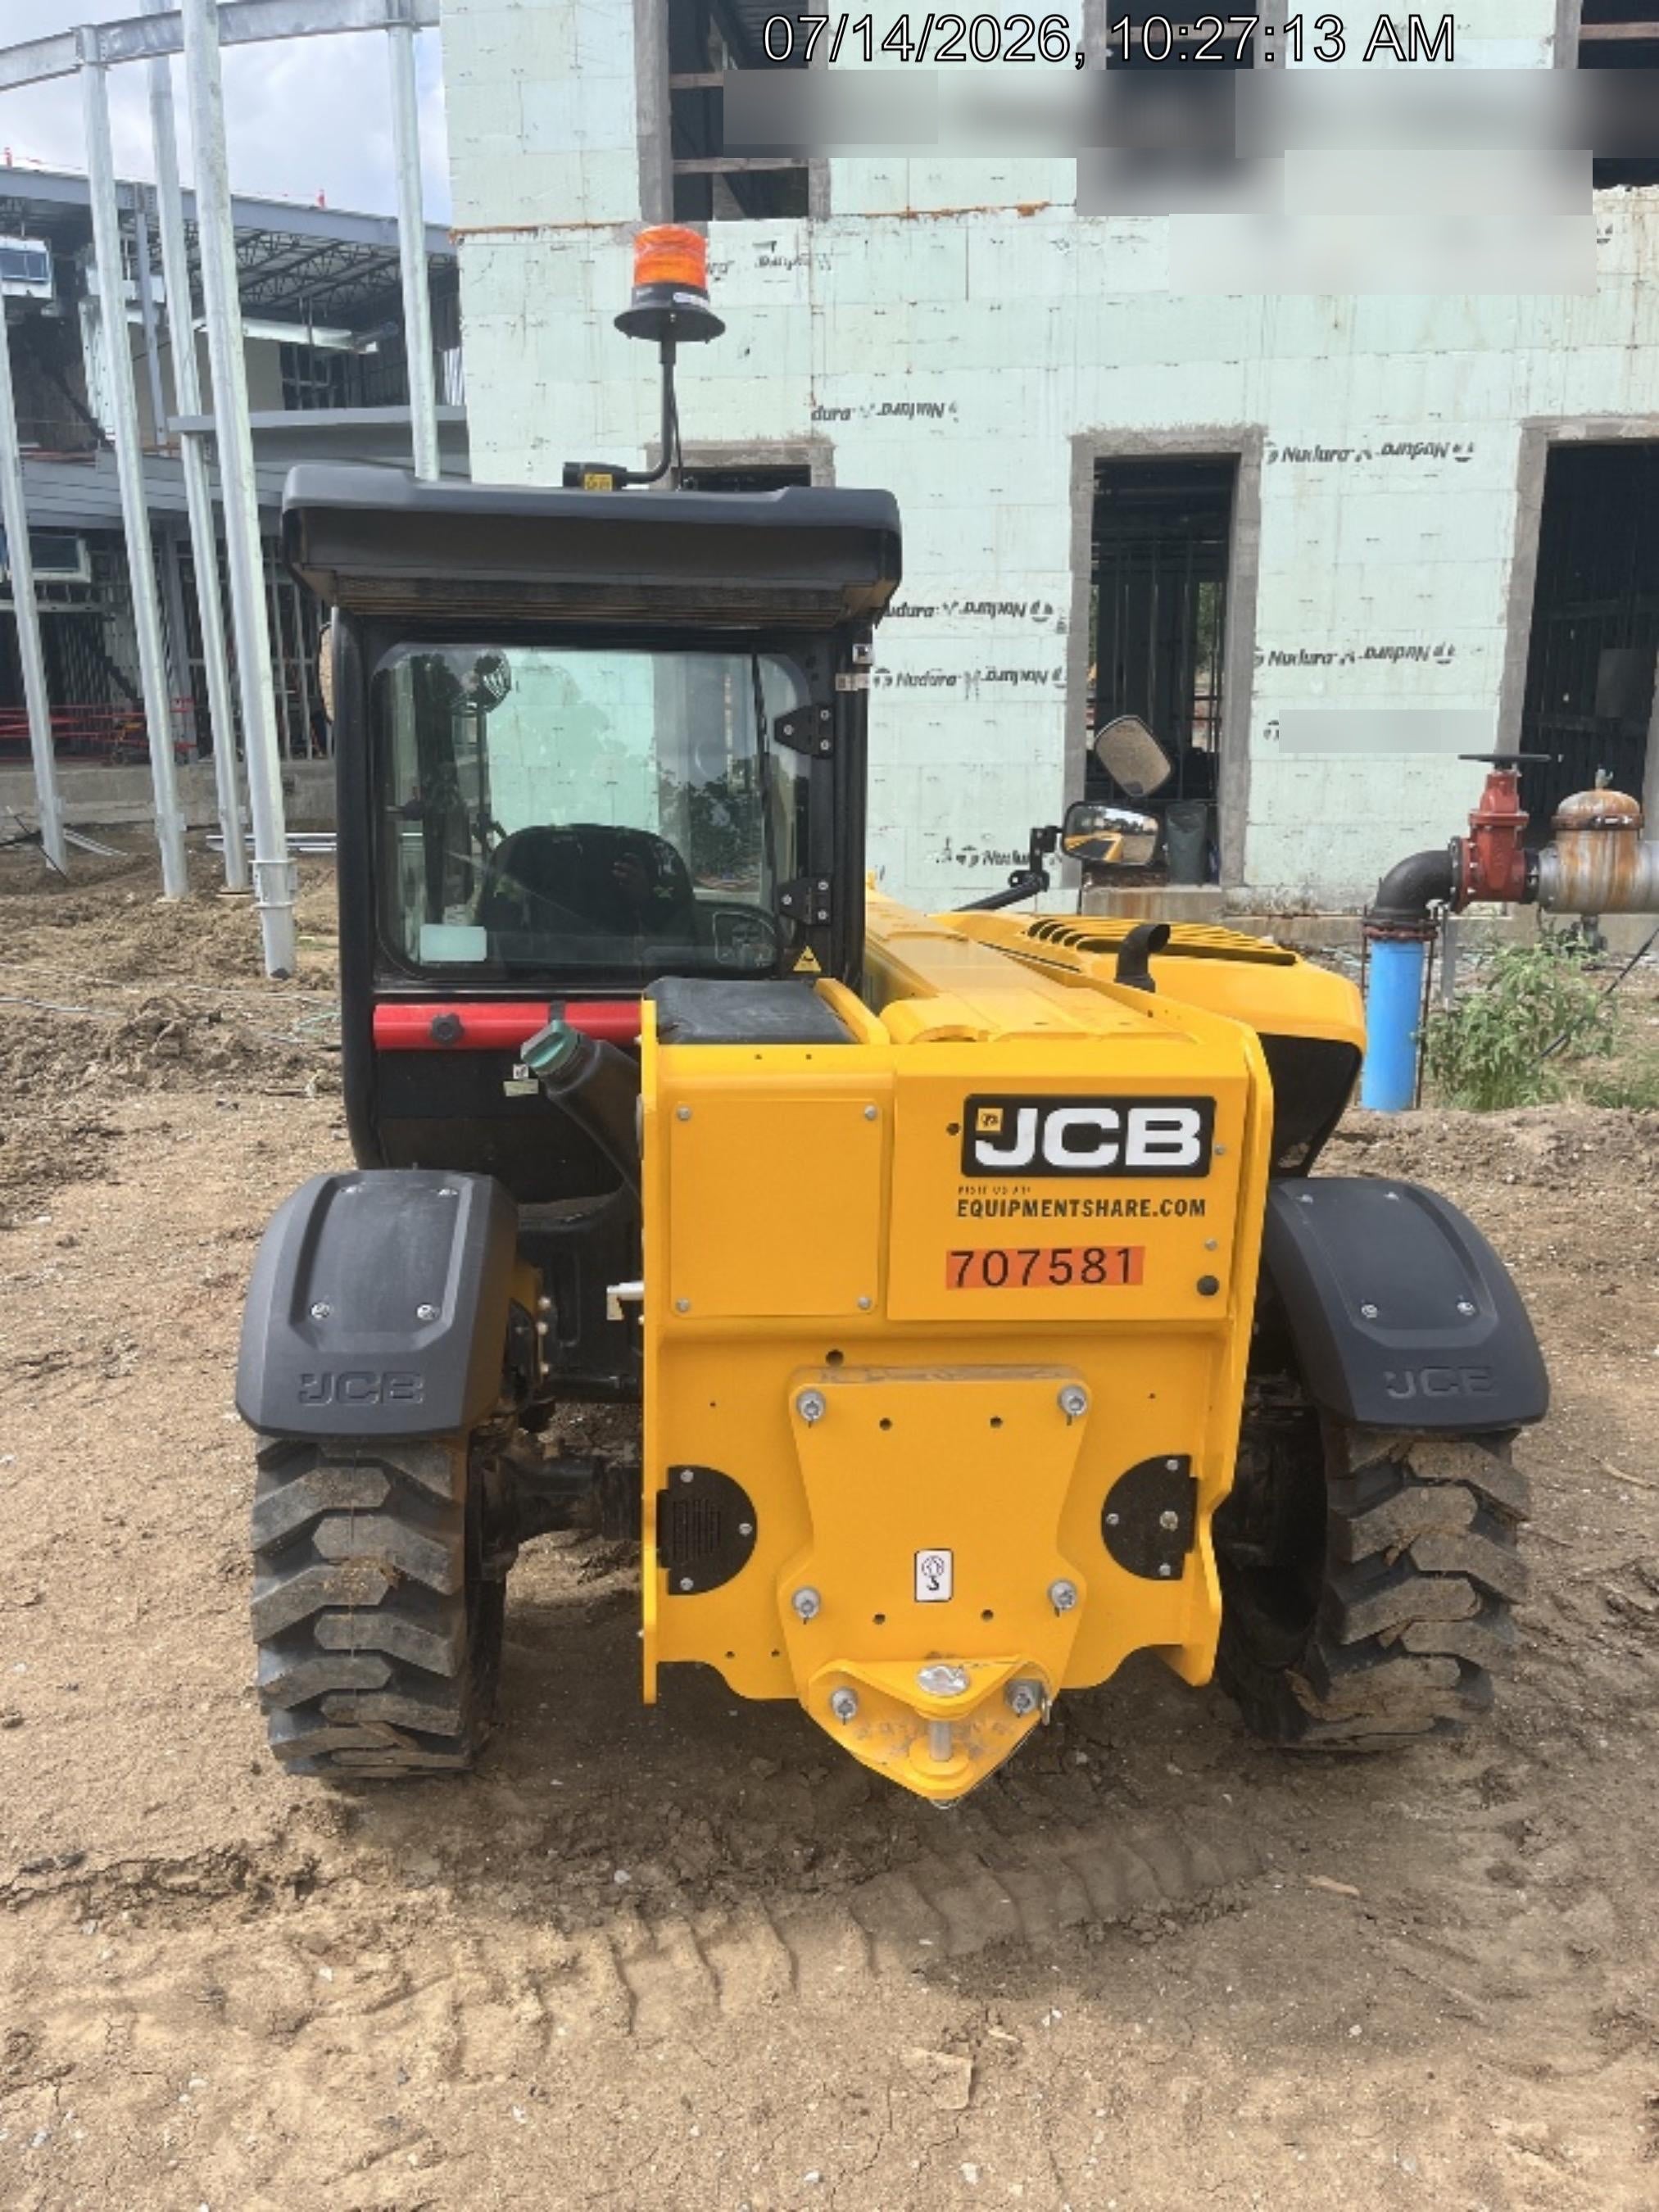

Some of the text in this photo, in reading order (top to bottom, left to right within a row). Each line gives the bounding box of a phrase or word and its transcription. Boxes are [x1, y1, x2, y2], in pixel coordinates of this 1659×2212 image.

[1281, 445, 1352, 463] Nudura
[887, 601, 936, 618] udura
[1267, 648, 1335, 666] Nudura
[896, 670, 958, 687] Nudura
[975, 1107, 1201, 1167] JCB
[957, 1199, 1206, 1218] EQUIPMENTSHARE.COM
[950, 1247, 1131, 1288] 707581
[299, 1371, 424, 1407] JCB
